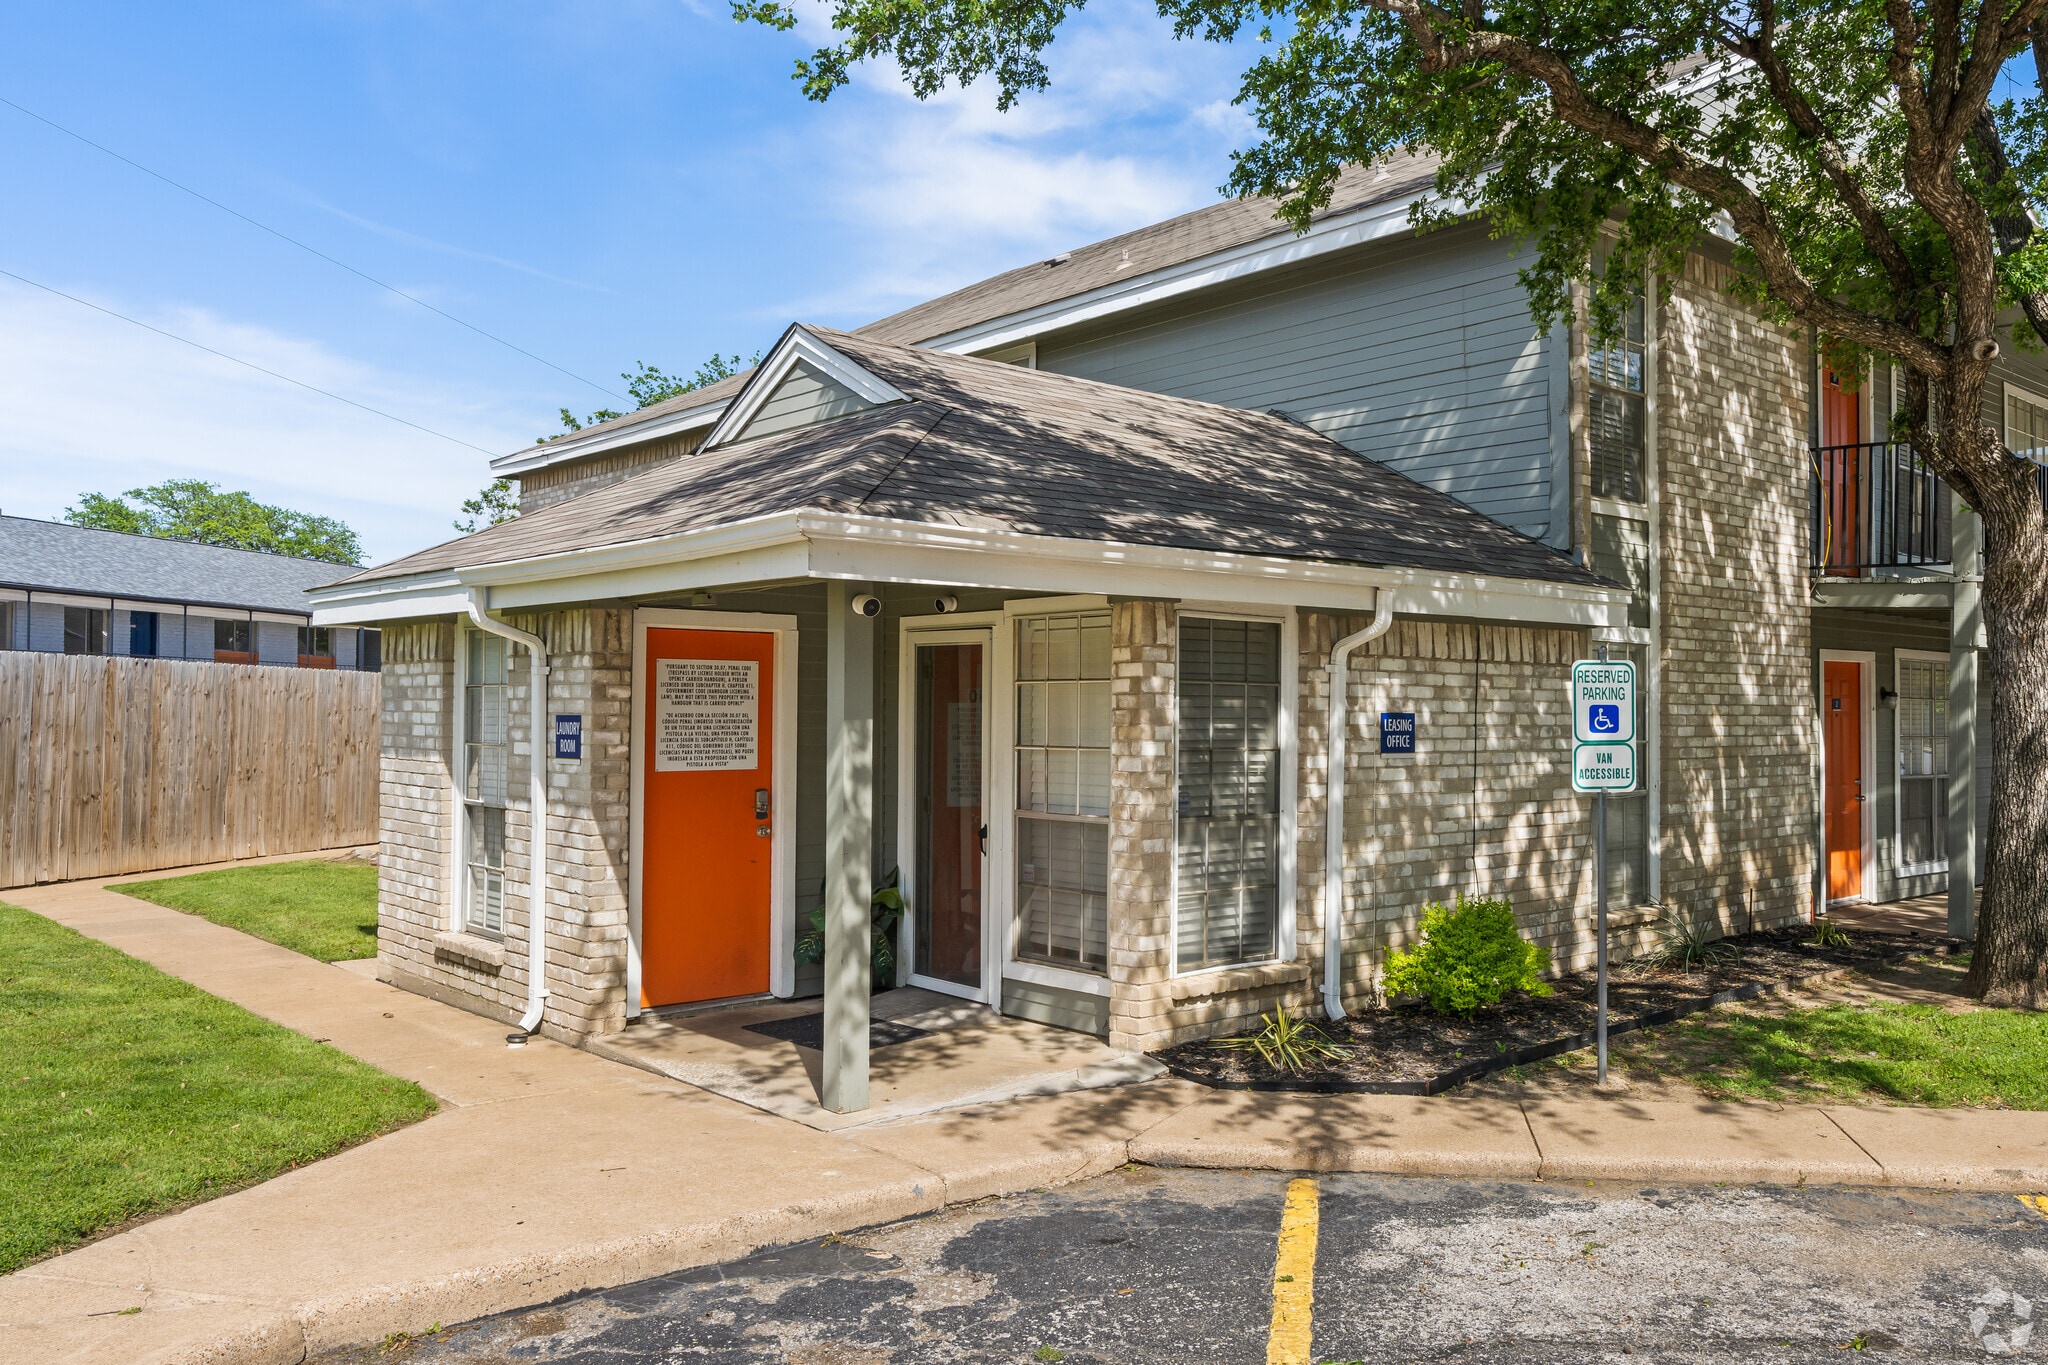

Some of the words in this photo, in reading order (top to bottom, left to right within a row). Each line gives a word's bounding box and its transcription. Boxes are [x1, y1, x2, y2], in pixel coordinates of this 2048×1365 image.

[1578, 670, 1630, 683] RESERVED
[1582, 687, 1625, 700] PARKING
[556, 722, 580, 735] LAUNDRY
[1384, 719, 1412, 731] LEASING
[560, 739, 575, 752] ROOM
[1386, 735, 1410, 747] OFFICE
[1596, 753, 1612, 763] VAN
[1579, 768, 1630, 779] ACCESSIBLE
